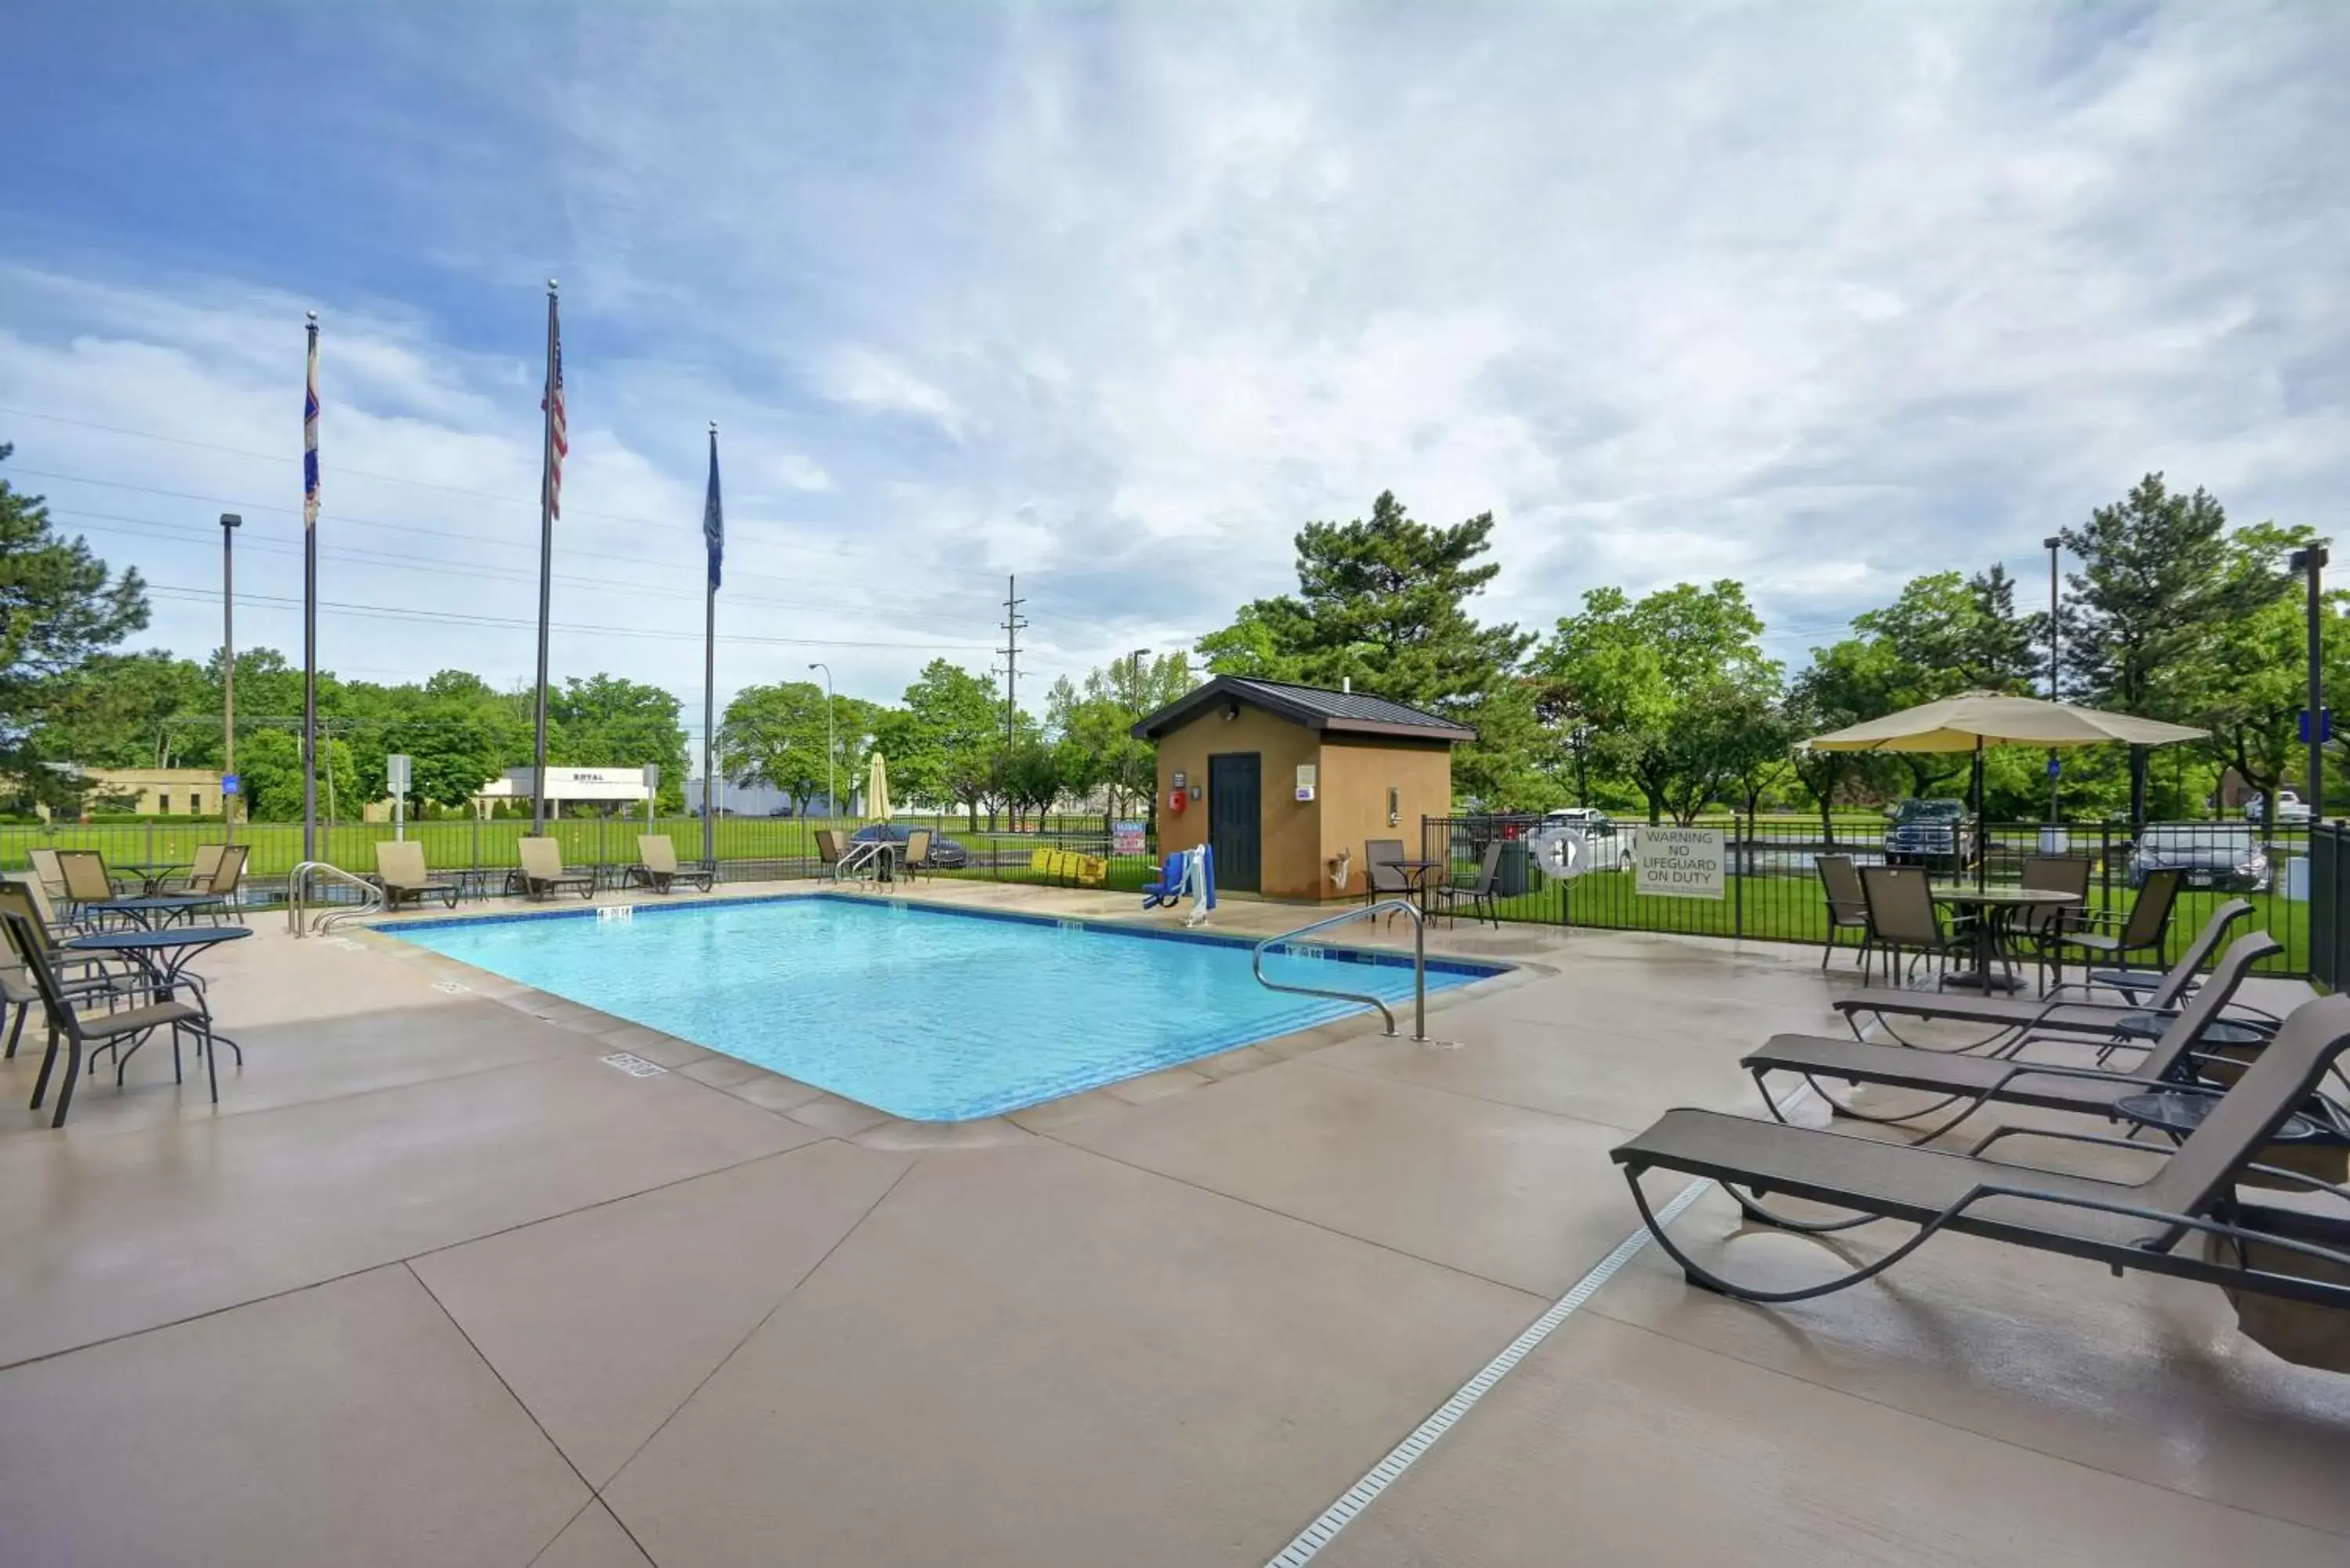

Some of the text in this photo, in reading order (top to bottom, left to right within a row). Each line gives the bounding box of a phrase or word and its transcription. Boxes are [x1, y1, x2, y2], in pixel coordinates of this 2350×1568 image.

[1647, 832, 1713, 844] WARNING
[1668, 846, 1690, 856] NO
[1643, 857, 1716, 871] LIFEGUARD
[1647, 870, 1711, 884] ON DUTY
